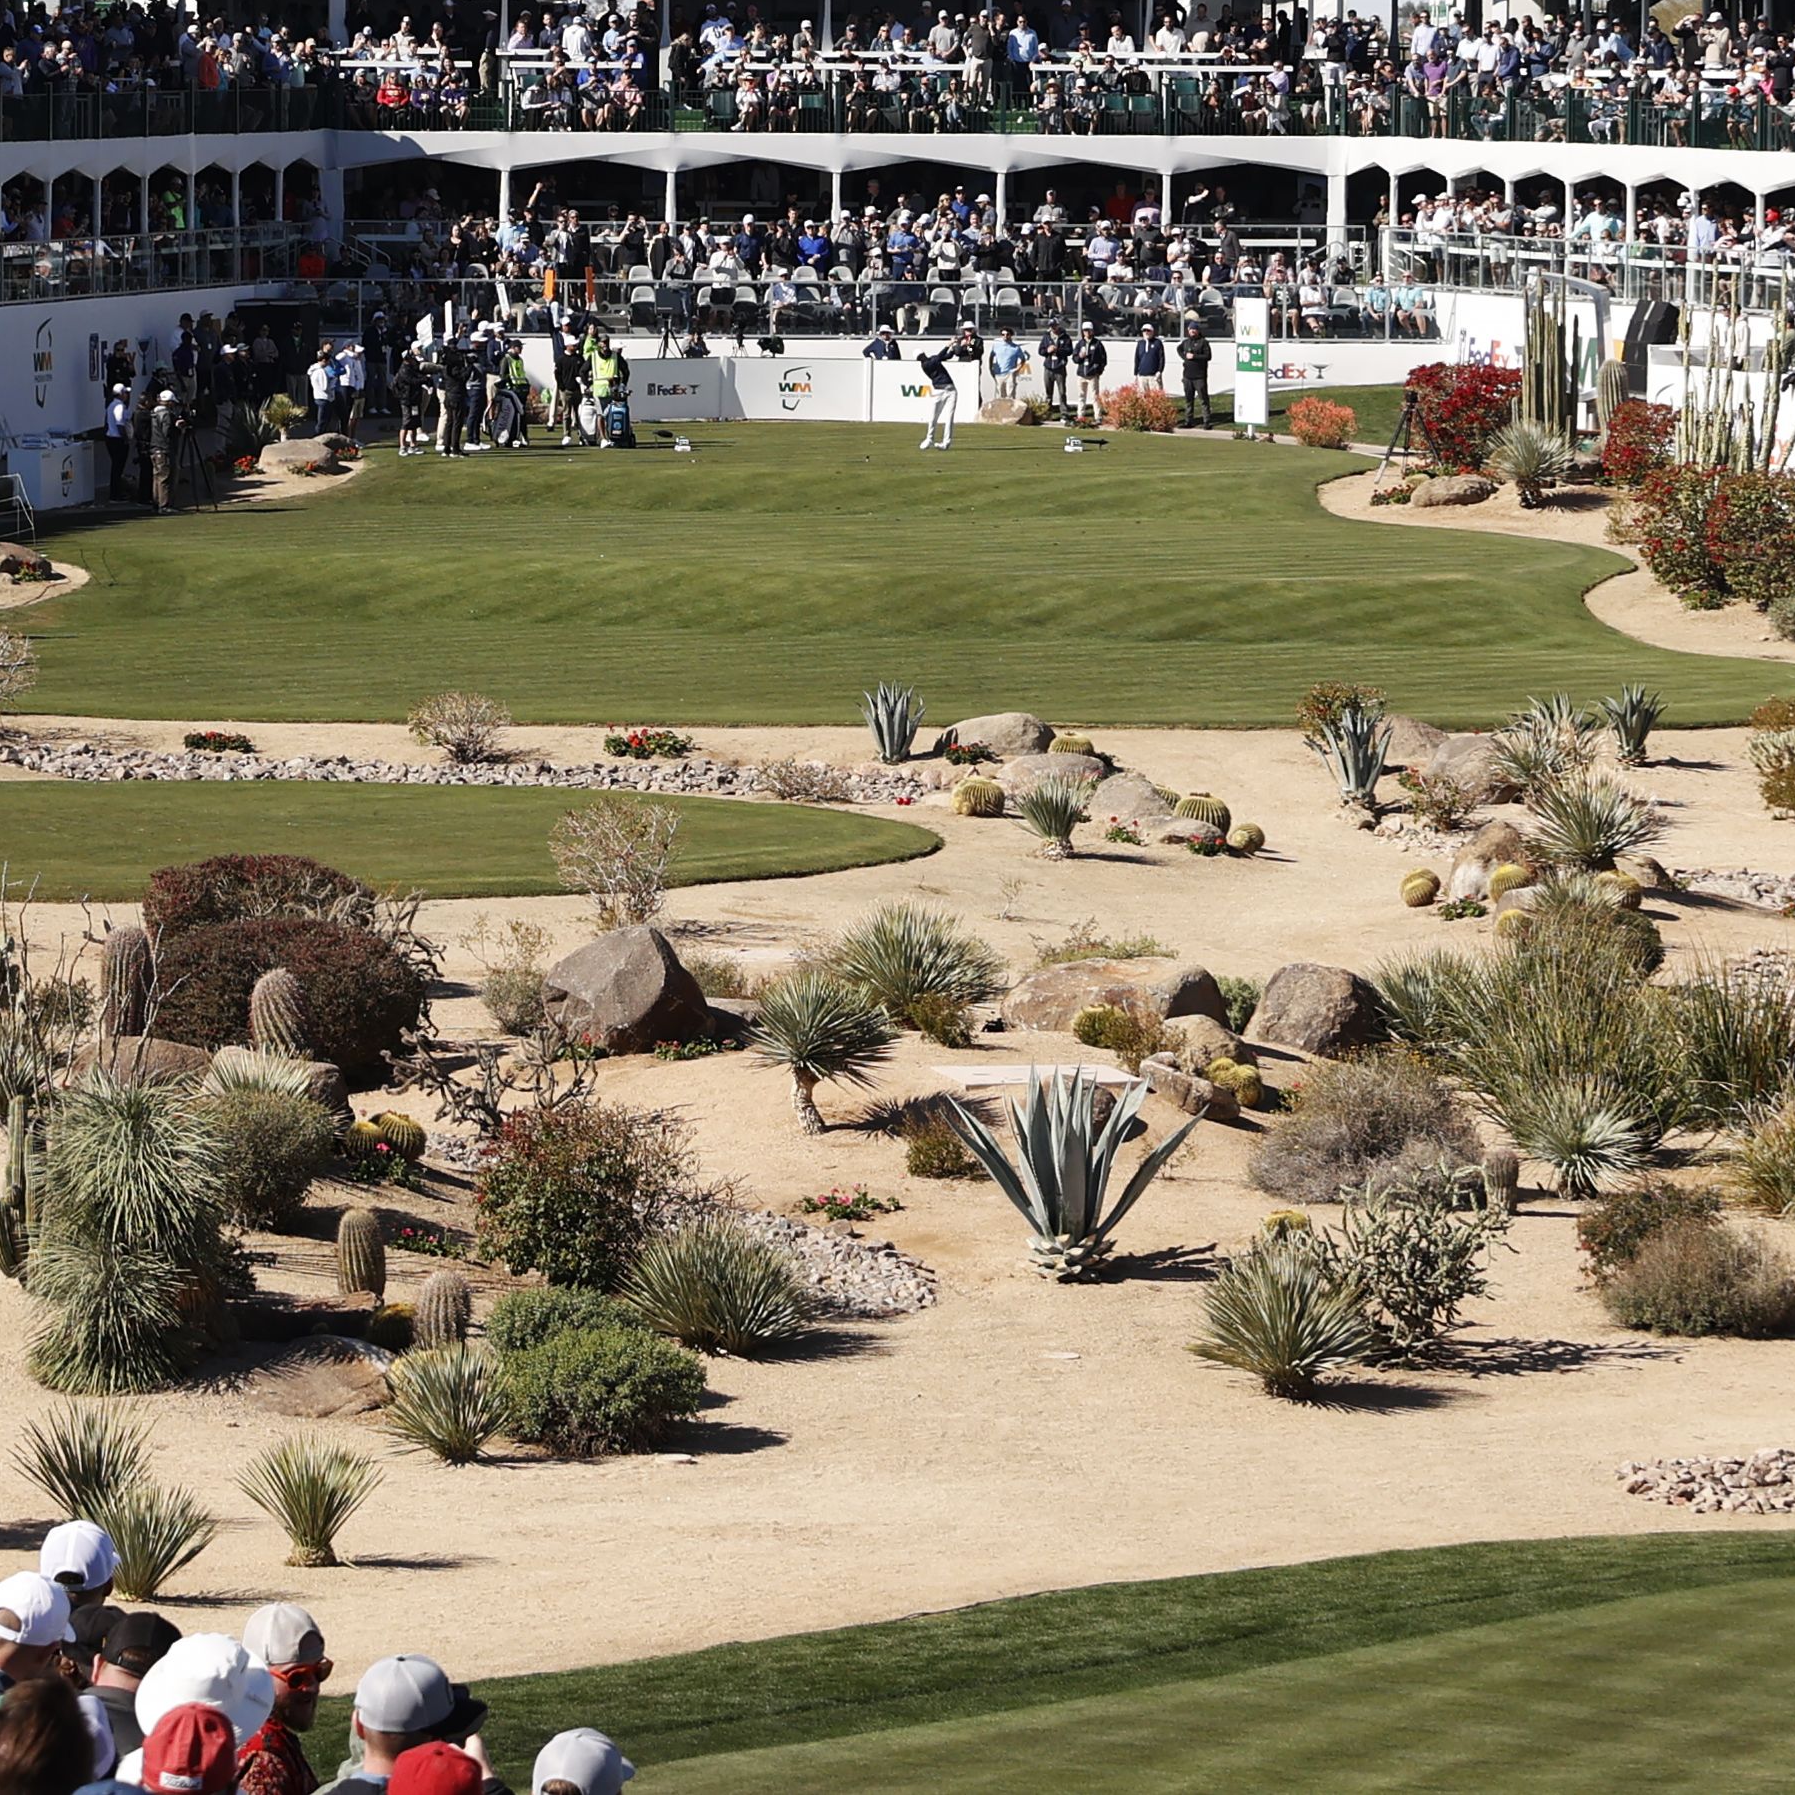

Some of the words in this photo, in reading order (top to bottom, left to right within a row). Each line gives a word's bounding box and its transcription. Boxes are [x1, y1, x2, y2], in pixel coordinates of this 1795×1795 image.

[33, 351, 53, 372] WM
[1237, 346, 1250, 362] 16
[1268, 363, 1307, 379] edEx
[657, 384, 688, 396] FedEx
[779, 382, 811, 393] WM
